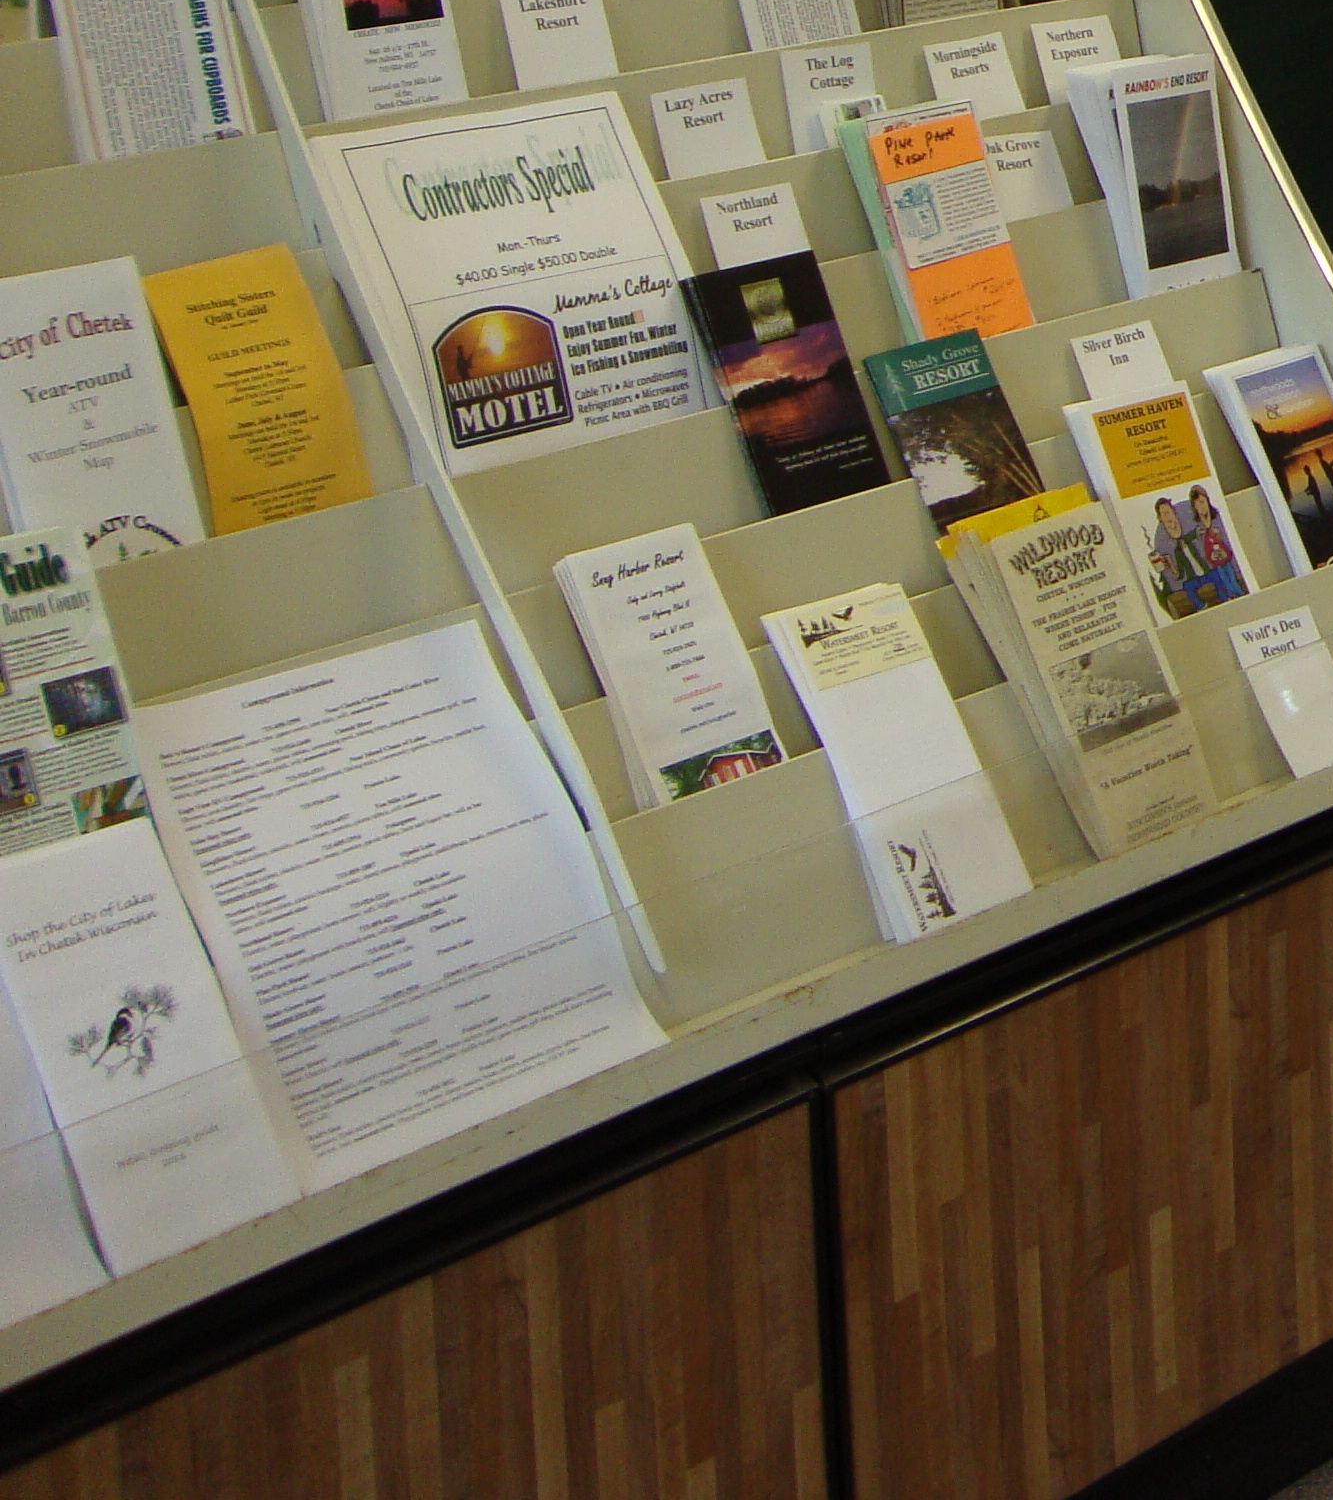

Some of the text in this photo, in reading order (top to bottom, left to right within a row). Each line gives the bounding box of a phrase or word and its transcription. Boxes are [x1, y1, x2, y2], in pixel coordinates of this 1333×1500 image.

[536, 15, 579, 31] Resort
[1046, 27, 1094, 43] Northern
[197, 35, 214, 57] FOR
[932, 40, 997, 64] Morningside
[1051, 45, 1099, 61] Exposure
[806, 55, 854, 72] The Log
[951, 61, 990, 80] Resorts
[200, 57, 230, 125] CUPBOARDS
[810, 74, 854, 90] Cottage
[1125, 70, 1209, 95] RAINBOW'S END RESORT
[665, 89, 733, 115] Lazy Acres
[683, 112, 724, 129] Resort
[1006, 138, 1040, 153] Grove
[996, 156, 1033, 171] Resort
[403, 145, 596, 222] Contractors Special
[716, 193, 778, 214] Northland
[733, 214, 773, 232] Resort
[456, 245, 618, 286] $40.00 Single $50.00 Double
[238, 289, 275, 304] Sisters
[624, 275, 674, 299] Cottage
[204, 303, 268, 327] Quilt Guild
[563, 311, 636, 340] Open Year Round
[39, 310, 134, 347] of Chetek
[567, 321, 678, 360] Enjoy Summer Winter
[1082, 327, 1145, 354] Silver Birch
[207, 338, 291, 362] GUILD MEETINGS
[571, 339, 689, 377] Ice Fishing Snowmobiling
[901, 343, 981, 373] Shady Grove
[1110, 353, 1129, 367] Inn
[20, 363, 133, 404] Year-round
[448, 362, 557, 400] MAMMA'S COTTAGE
[574, 366, 688, 401] Cable TV Air conditioning
[912, 360, 981, 390] RESORT
[67, 396, 100, 415] ATV
[455, 385, 564, 436] MOTEL
[577, 380, 690, 415] Refrigerators Microwaves
[585, 393, 689, 427] Picnic Area with BBQ Grill
[1098, 397, 1184, 427] SUMMER HAVEN
[1125, 419, 1167, 438] RESORT
[27, 422, 159, 465] Winter Snowmobile
[83, 455, 115, 470] Map
[1009, 524, 1105, 575] WILDWOOD
[0, 542, 69, 598] Guide
[618, 550, 685, 581] Harbor Resort
[1031, 547, 1097, 589] RESORT
[1098, 585, 1127, 603] RESORT
[3, 601, 47, 626] Barron
[1242, 617, 1301, 644] Wolf's Den
[1260, 639, 1297, 659] Resort
[6, 927, 41, 949] Shop
[43, 920, 67, 938] the
[68, 910, 97, 934] City
[99, 903, 114, 920] of
[18, 910, 158, 963] In Chetek Wisconsin
